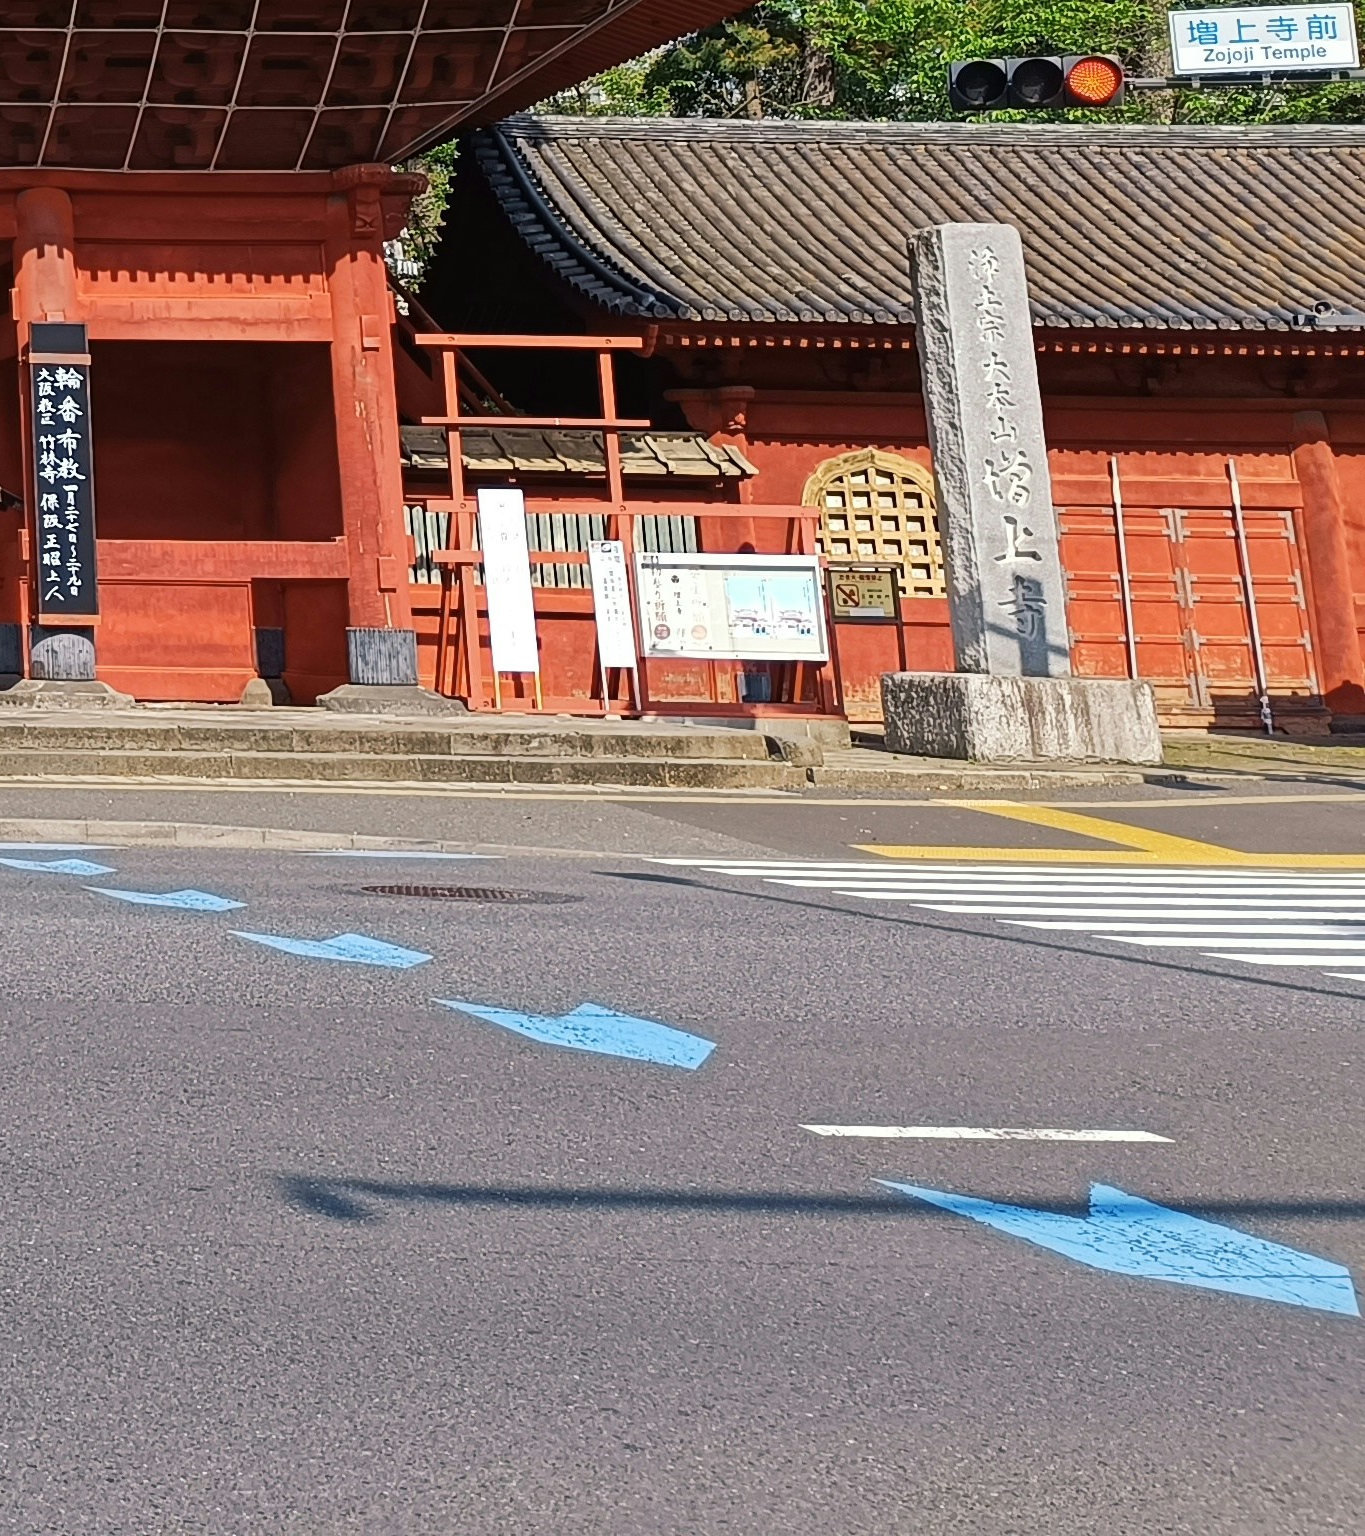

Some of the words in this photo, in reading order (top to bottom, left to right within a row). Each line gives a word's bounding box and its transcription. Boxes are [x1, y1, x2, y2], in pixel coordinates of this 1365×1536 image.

[1187, 14, 1338, 45] 増上寺前
[1203, 47, 1254, 64] Zojoji
[1261, 44, 1327, 62] Temple
